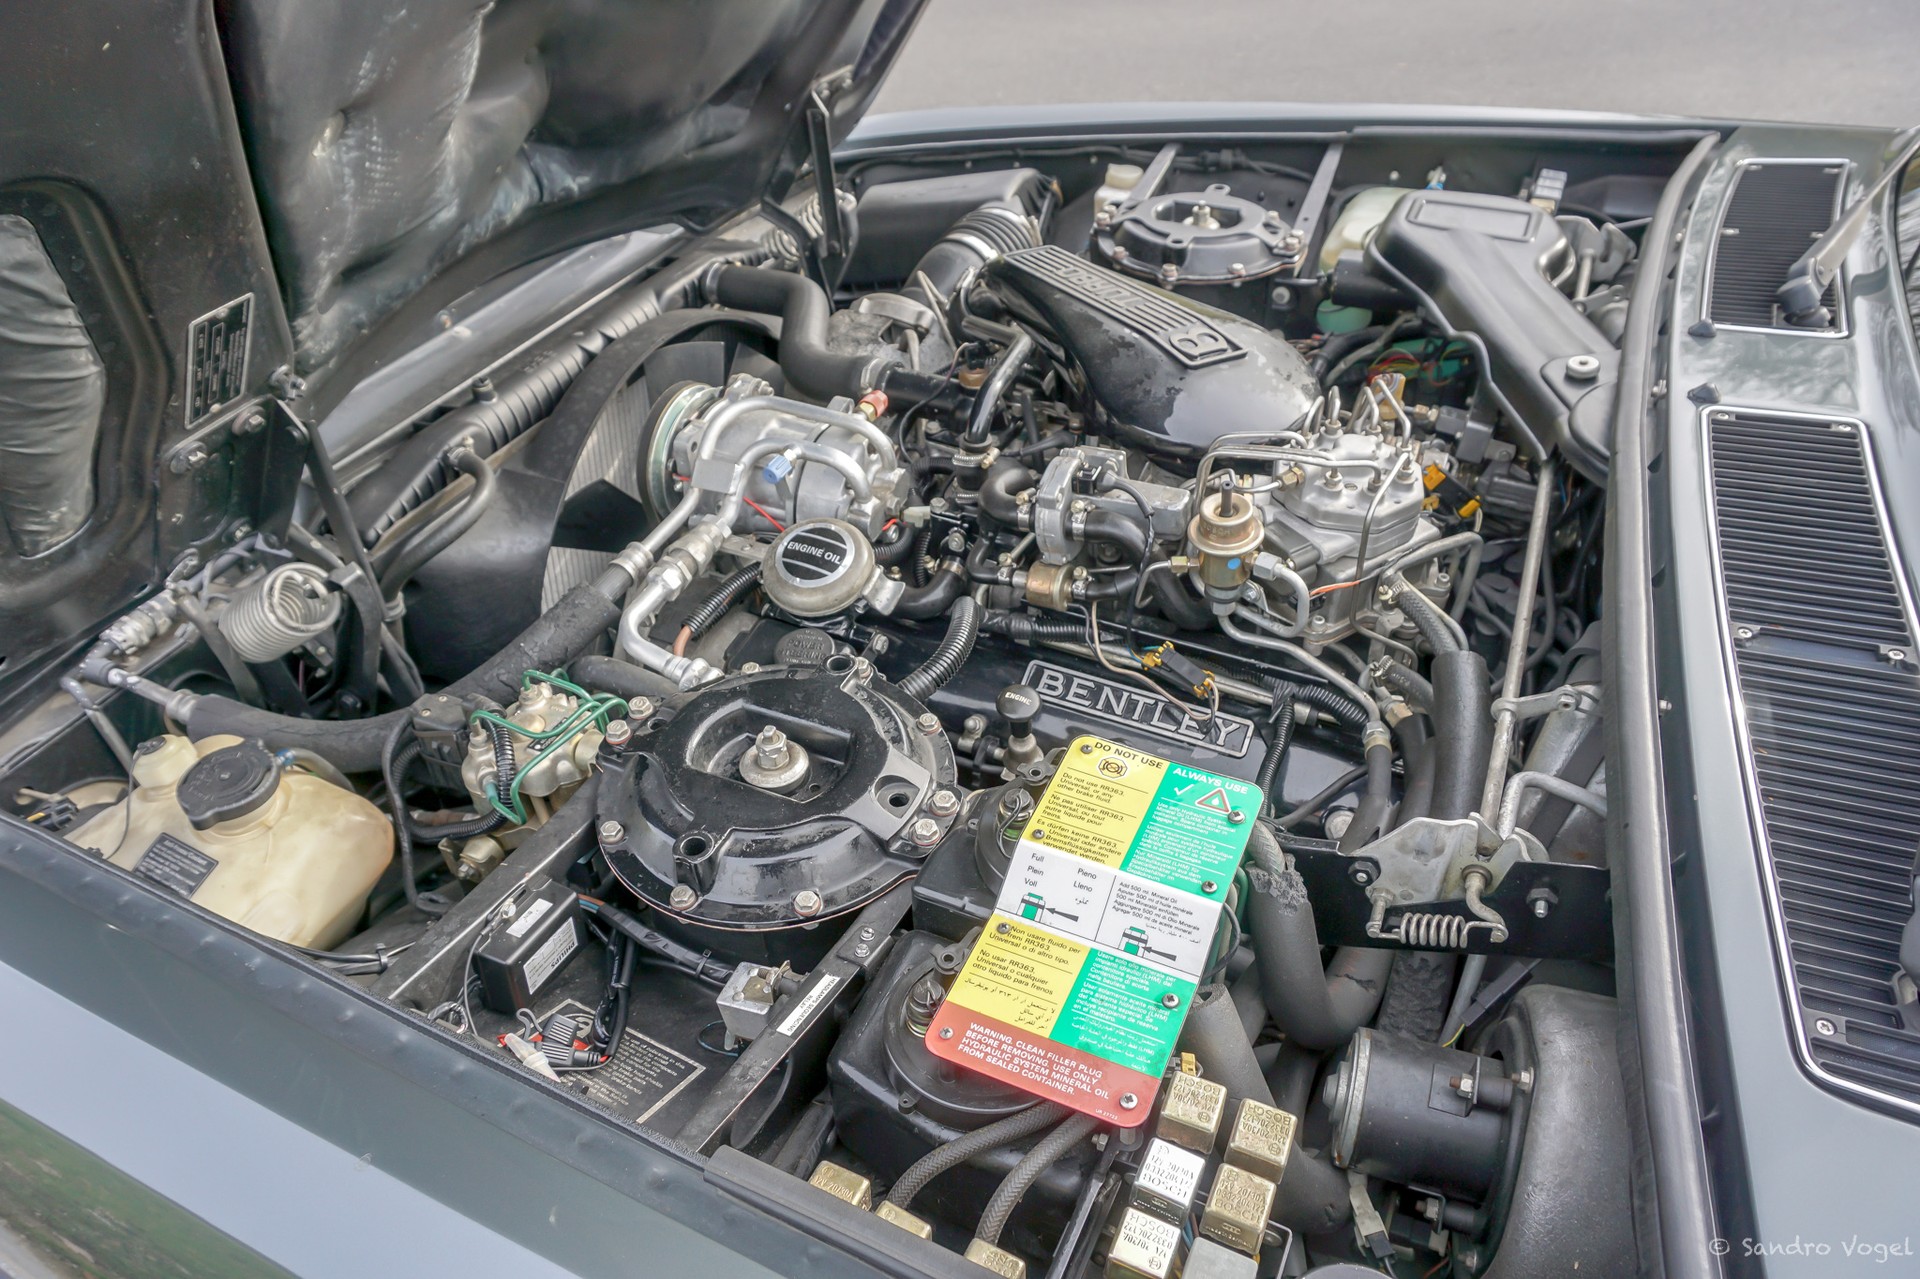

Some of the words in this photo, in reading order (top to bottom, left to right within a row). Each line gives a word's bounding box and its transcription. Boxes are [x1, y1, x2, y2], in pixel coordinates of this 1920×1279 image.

[787, 542, 824, 558] ENGINE
[824, 552, 841, 564] OIL
[787, 639, 824, 650] POWER
[1005, 692, 1031, 705] ENGINE
[1036, 669, 1241, 746] BENTLEY
[1094, 742, 1110, 751] DO
[1114, 748, 1138, 760] NOT
[1140, 757, 1162, 768] USE
[1172, 767, 1224, 787] ALWAYS
[1225, 782, 1248, 794] USE
[1076, 789, 1093, 797] brake
[1042, 810, 1061, 818] freins.
[1063, 811, 1084, 821] liquide
[1075, 802, 1096, 812] utiliser
[1047, 822, 1069, 832] dürfen
[1071, 830, 1089, 838] keine
[1042, 841, 1076, 854] verwendet
[1079, 852, 1106, 863] werden.
[1048, 829, 1079, 841] Universal
[1098, 845, 1121, 855] andere
[1031, 853, 1044, 861] Full
[1027, 866, 1044, 875] Plein
[1077, 868, 1097, 878] Pieno
[1023, 878, 1037, 886] Voll
[1073, 881, 1092, 891] Lleno
[1007, 932, 1022, 940] freni
[1027, 932, 1045, 941] usare
[1048, 939, 1066, 948] fluido
[550, 942, 575, 969] PHILIPS
[989, 933, 1020, 947] Universal
[1038, 950, 1052, 958] altro
[1054, 956, 1070, 965] tipo.
[976, 956, 1008, 970] Universal
[1016, 970, 1047, 985] cualquier
[812, 978, 836, 1004] HEADLAMPS
[1013, 978, 1028, 986] para
[1031, 983, 1053, 994] frenos
[800, 995, 813, 1008] RELAY
[787, 1004, 812, 1032] SEQUENCING
[962, 1037, 1010, 1060] HYDRAULIC
[1013, 1057, 1048, 1075] SYSTEM
[1050, 1071, 1092, 1092] MINERAL
[1094, 1088, 1109, 1098] OIL
[966, 1030, 998, 1047] BEFORE
[1052, 1063, 1070, 1074] USE
[1072, 1071, 1097, 1085] ONLY
[1015, 1040, 1044, 1056] CLEAN
[1046, 1052, 1076, 1068] FILLER
[1078, 1064, 1102, 1078] PLUG
[957, 1044, 983, 1059] FROM
[985, 1055, 1019, 1073] SEALED
[1021, 1069, 1075, 1094] CONTAINER.
[1177, 1075, 1220, 1096] BOSCH
[1248, 1104, 1291, 1125] BOSCH
[1241, 1121, 1269, 1141] 20/30A
[828, 1181, 854, 1199] 20/30A
[1214, 1198, 1262, 1222] BOSCH
